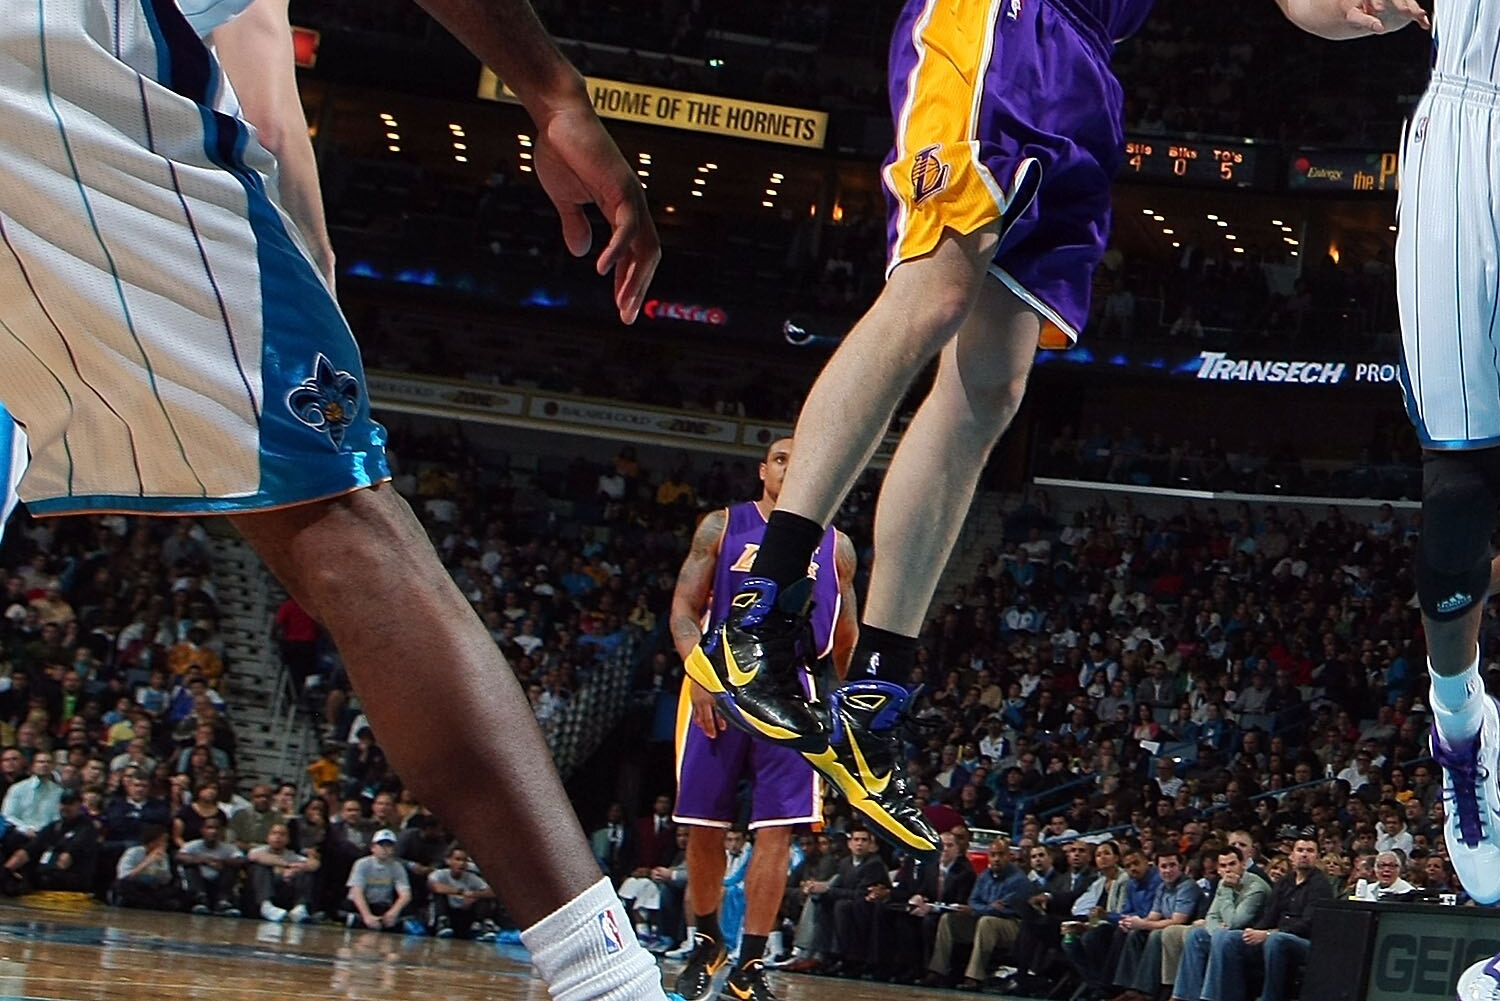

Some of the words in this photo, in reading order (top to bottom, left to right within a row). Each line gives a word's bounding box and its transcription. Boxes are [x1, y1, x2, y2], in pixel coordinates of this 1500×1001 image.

[593, 86, 651, 117] HOME
[656, 98, 682, 120] OF
[686, 100, 721, 127] THE
[726, 107, 818, 142] HORNETS
[1129, 155, 1142, 172] 4
[1173, 158, 1187, 177] 0
[1220, 161, 1233, 180] 5
[1353, 171, 1373, 191] the
[1196, 350, 1346, 384] TRANSECH
